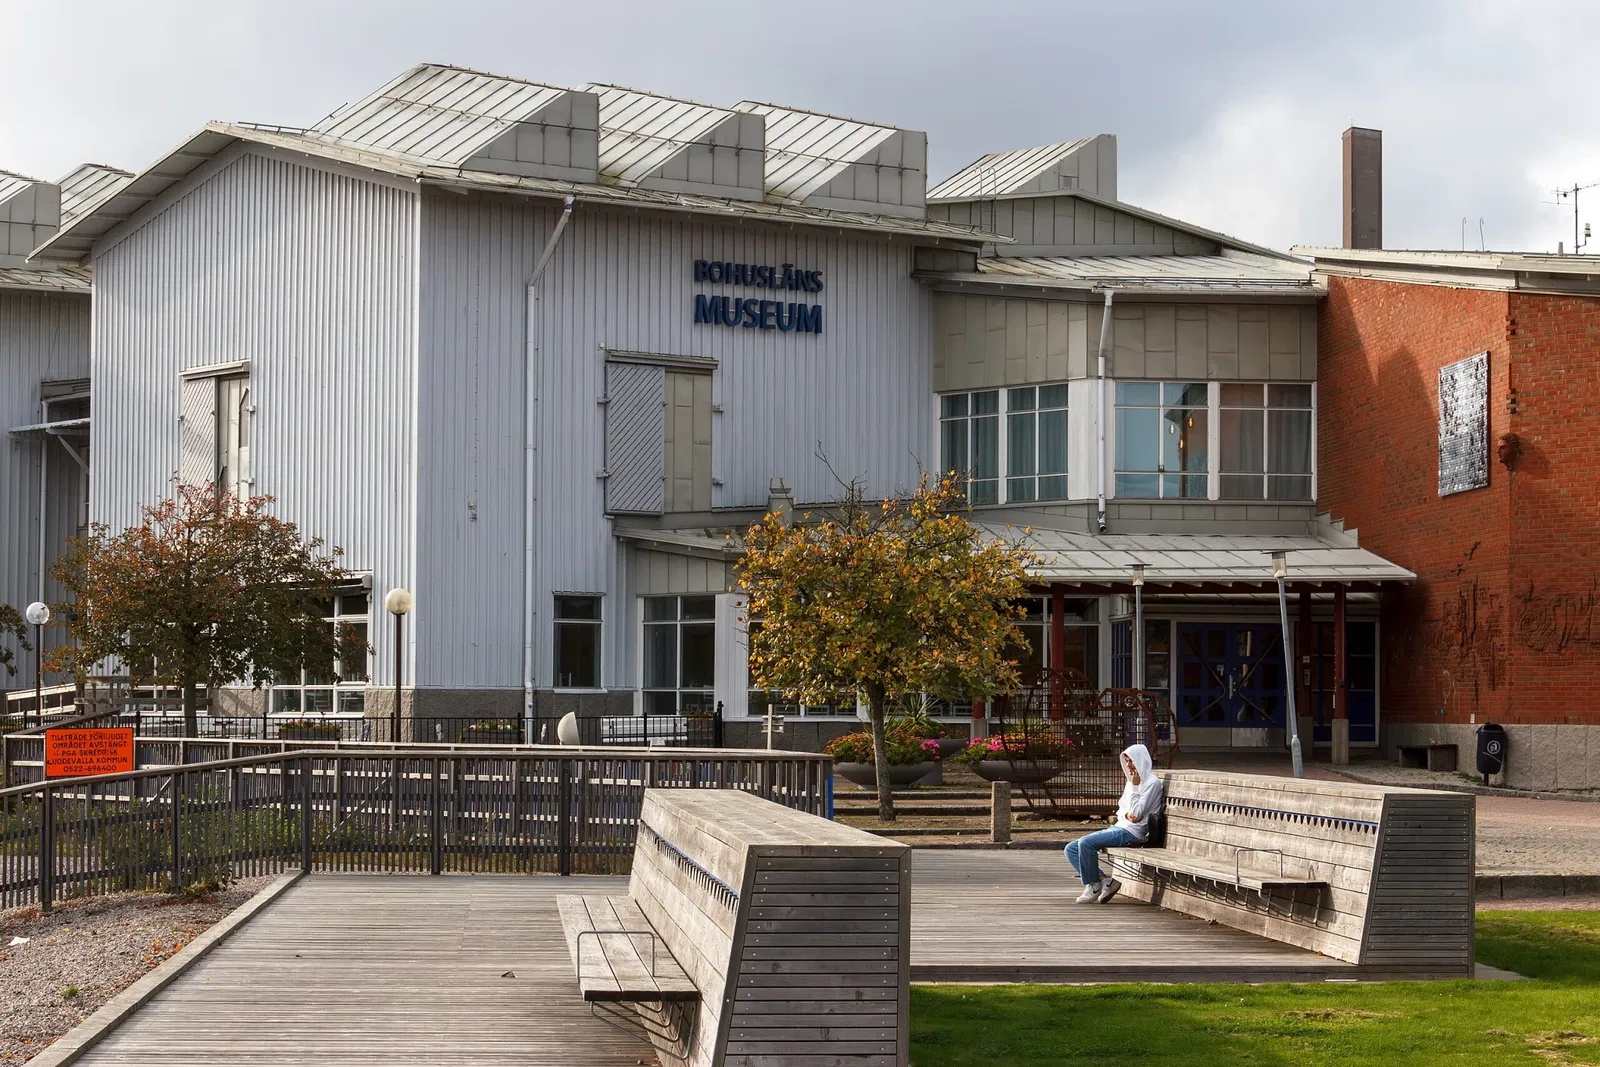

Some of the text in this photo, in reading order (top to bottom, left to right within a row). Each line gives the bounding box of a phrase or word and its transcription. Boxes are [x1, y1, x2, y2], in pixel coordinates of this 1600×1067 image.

[694, 259, 824, 293] BOHUSLÄNS
[694, 294, 823, 334] MUSEUM
[51, 732, 87, 741] TILLTRÄDE
[52, 740, 127, 749] OMRÅDET AVSTÄNGT
[63, 764, 117, 772] 0522-696400
